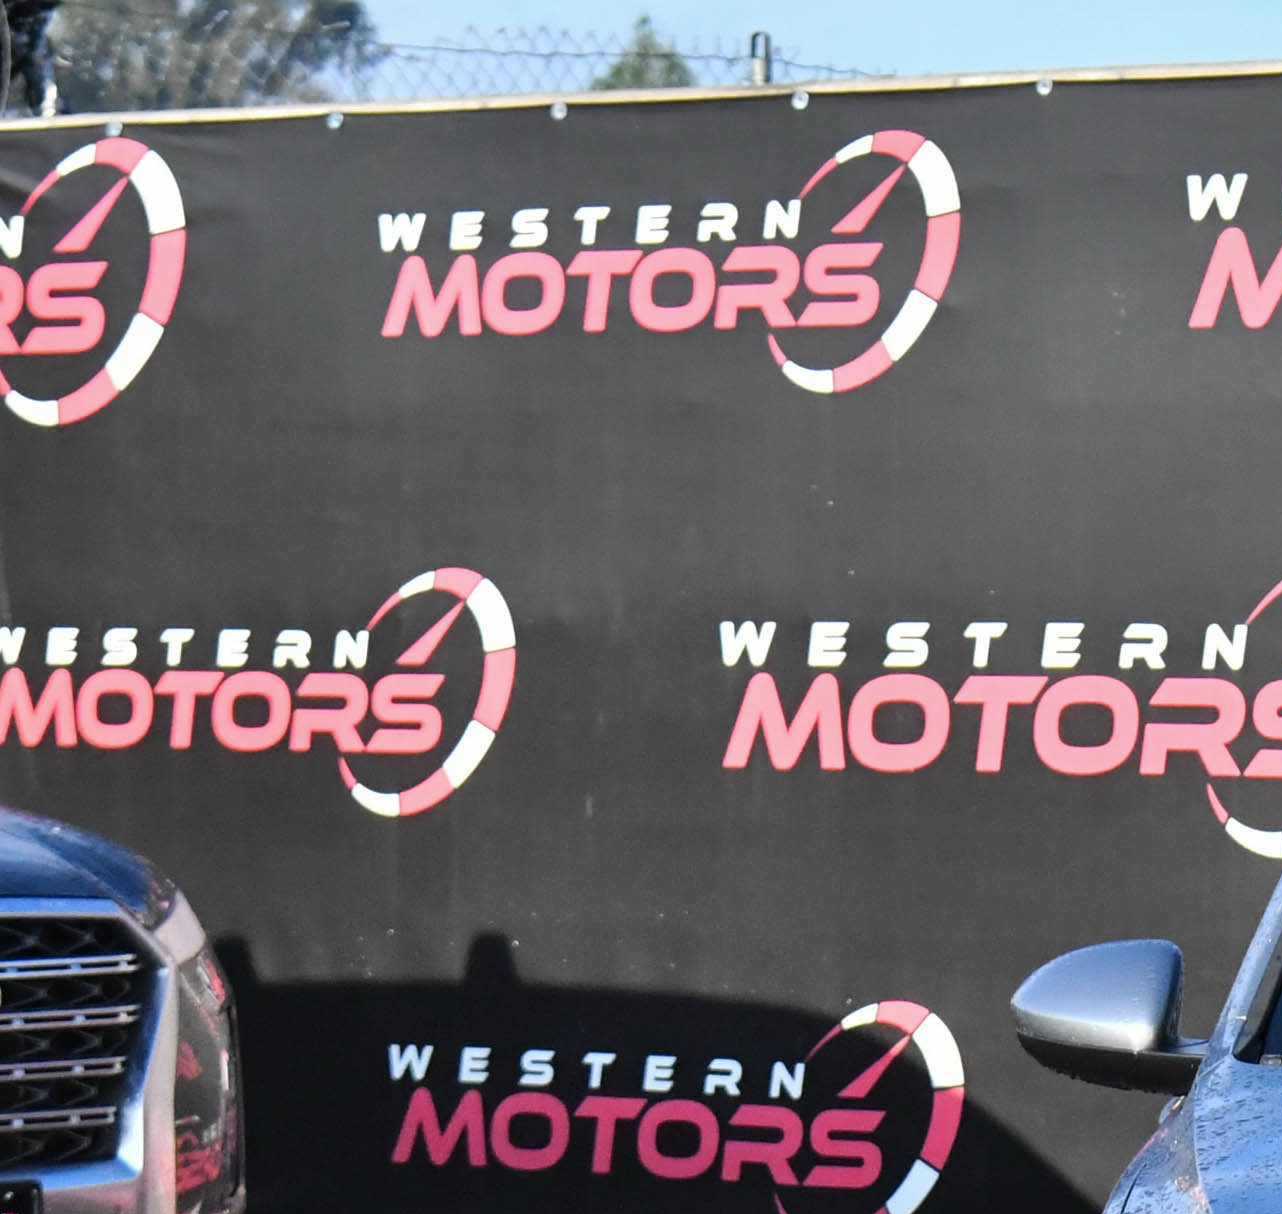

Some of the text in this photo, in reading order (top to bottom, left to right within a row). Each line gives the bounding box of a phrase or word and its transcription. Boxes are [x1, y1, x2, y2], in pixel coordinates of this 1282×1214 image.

[379, 199, 802, 252] WESTERN
[380, 242, 885, 338] MOTORS
[720, 620, 1249, 670] WESTERN
[0, 666, 446, 753] MOTORS
[389, 1043, 805, 1099] WESTERN
[391, 1086, 887, 1190] MOTORS
